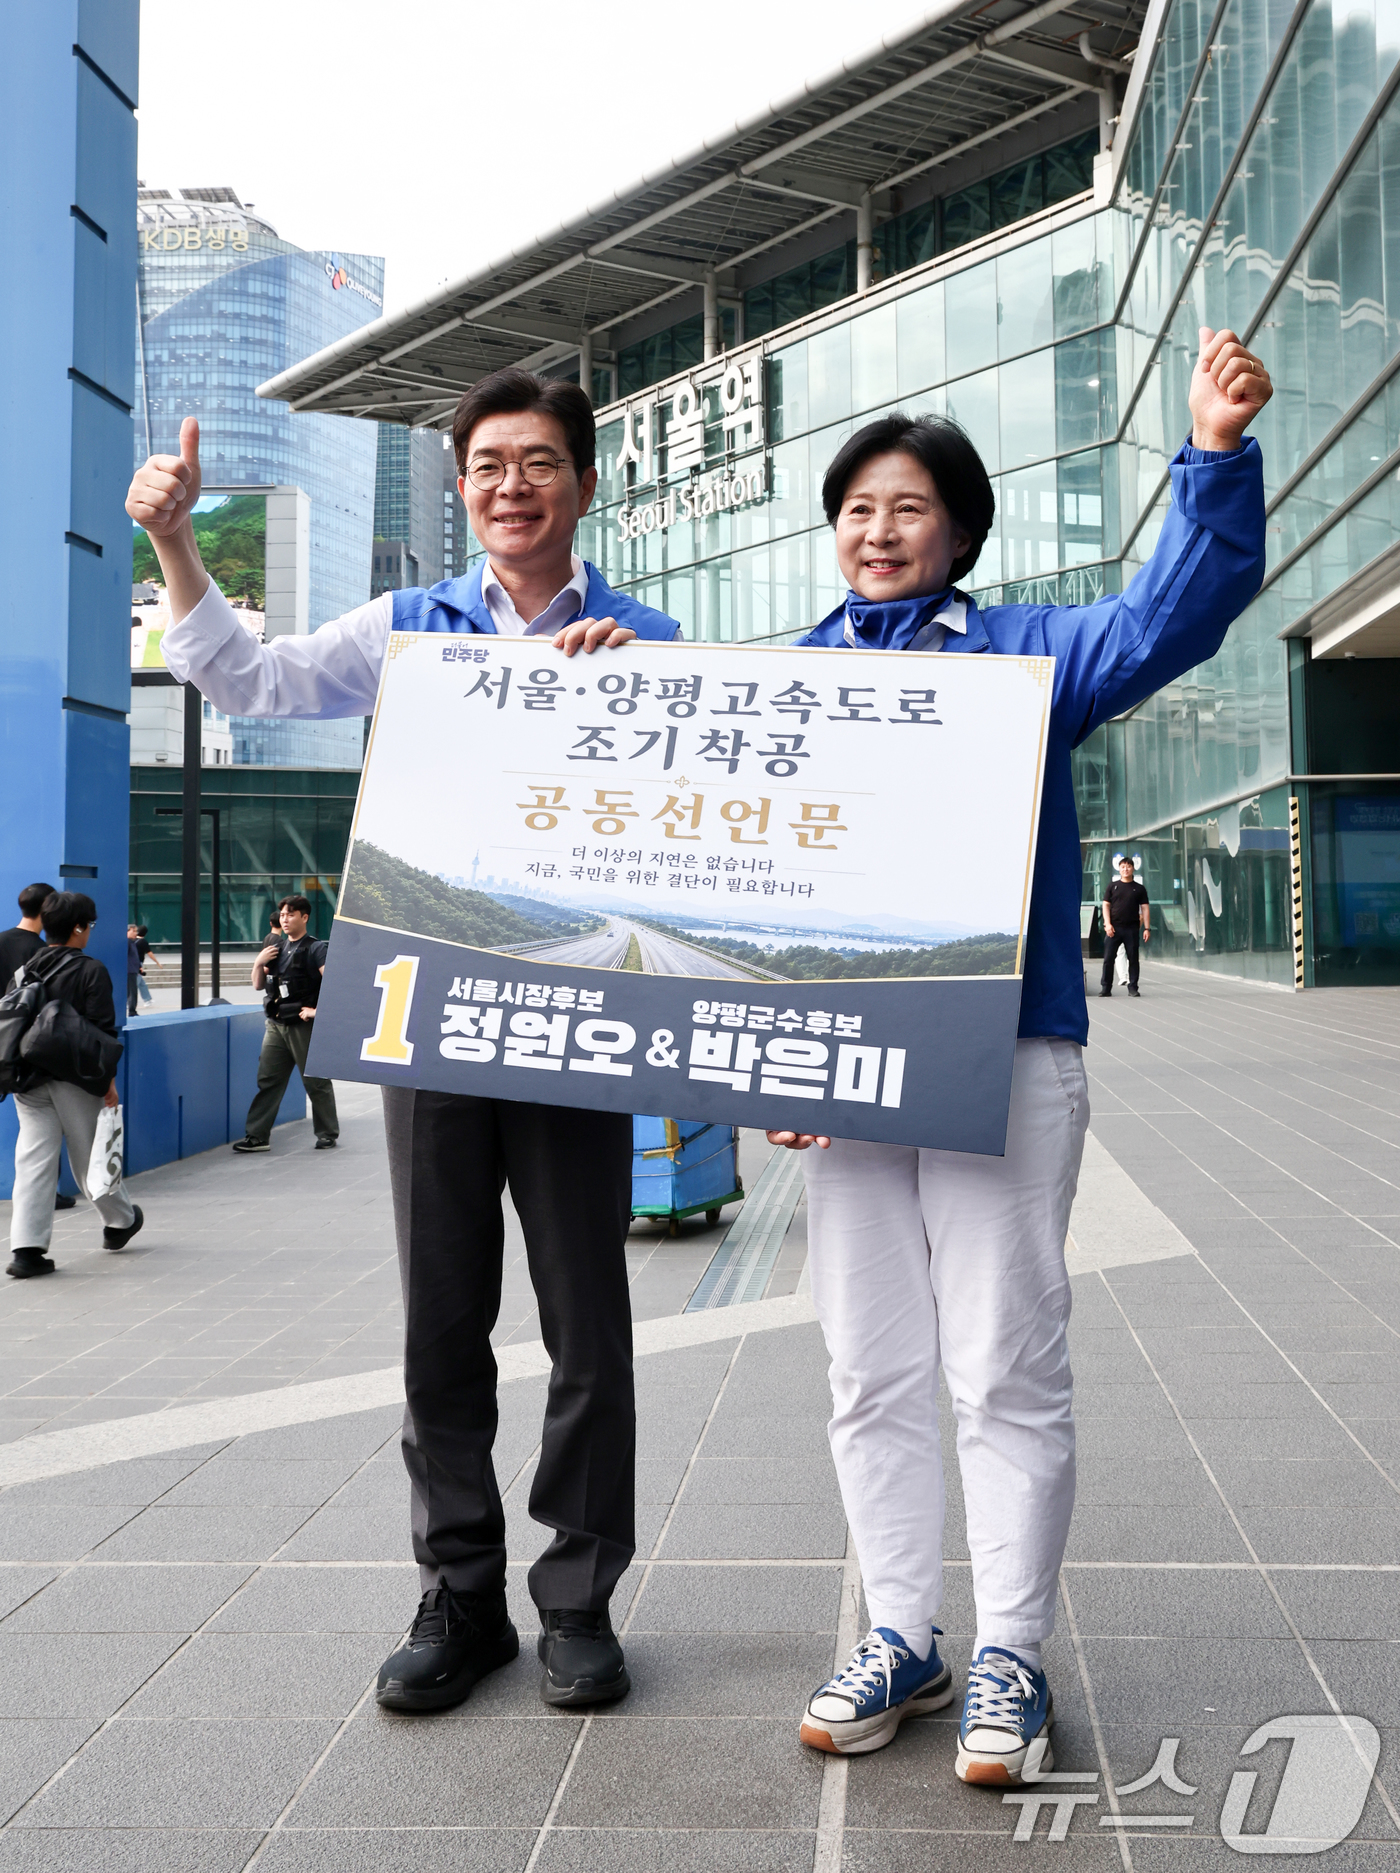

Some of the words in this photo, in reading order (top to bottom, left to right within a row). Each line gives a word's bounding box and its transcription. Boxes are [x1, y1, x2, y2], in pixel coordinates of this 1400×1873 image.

[144, 228, 249, 252] KDB생명
[325, 263, 335, 279] CJ
[616, 355, 764, 483] 서울역
[617, 487, 677, 542] Seoul
[679, 469, 765, 524] Station
[442, 648, 490, 663] 민주당
[463, 666, 943, 725] 서울·양평고속도로
[516, 785, 848, 850] 공동선언문
[572, 846, 586, 860] 더
[594, 847, 642, 864] 이상의
[649, 851, 698, 869] 지연은
[706, 855, 774, 874] 없습니다
[525, 862, 561, 879] 지금,
[569, 865, 618, 883] 국민을
[626, 870, 659, 886] 위한
[667, 873, 717, 890] 결단이
[726, 877, 815, 898] 필요합니다
[359, 954, 420, 1066] 1
[447, 977, 604, 1012] 서울시장후보
[692, 1000, 862, 1038] 양평군수후보
[439, 1003, 637, 1077] 정원오
[645, 1028, 680, 1069] &
[688, 1029, 906, 1108] 박은미
